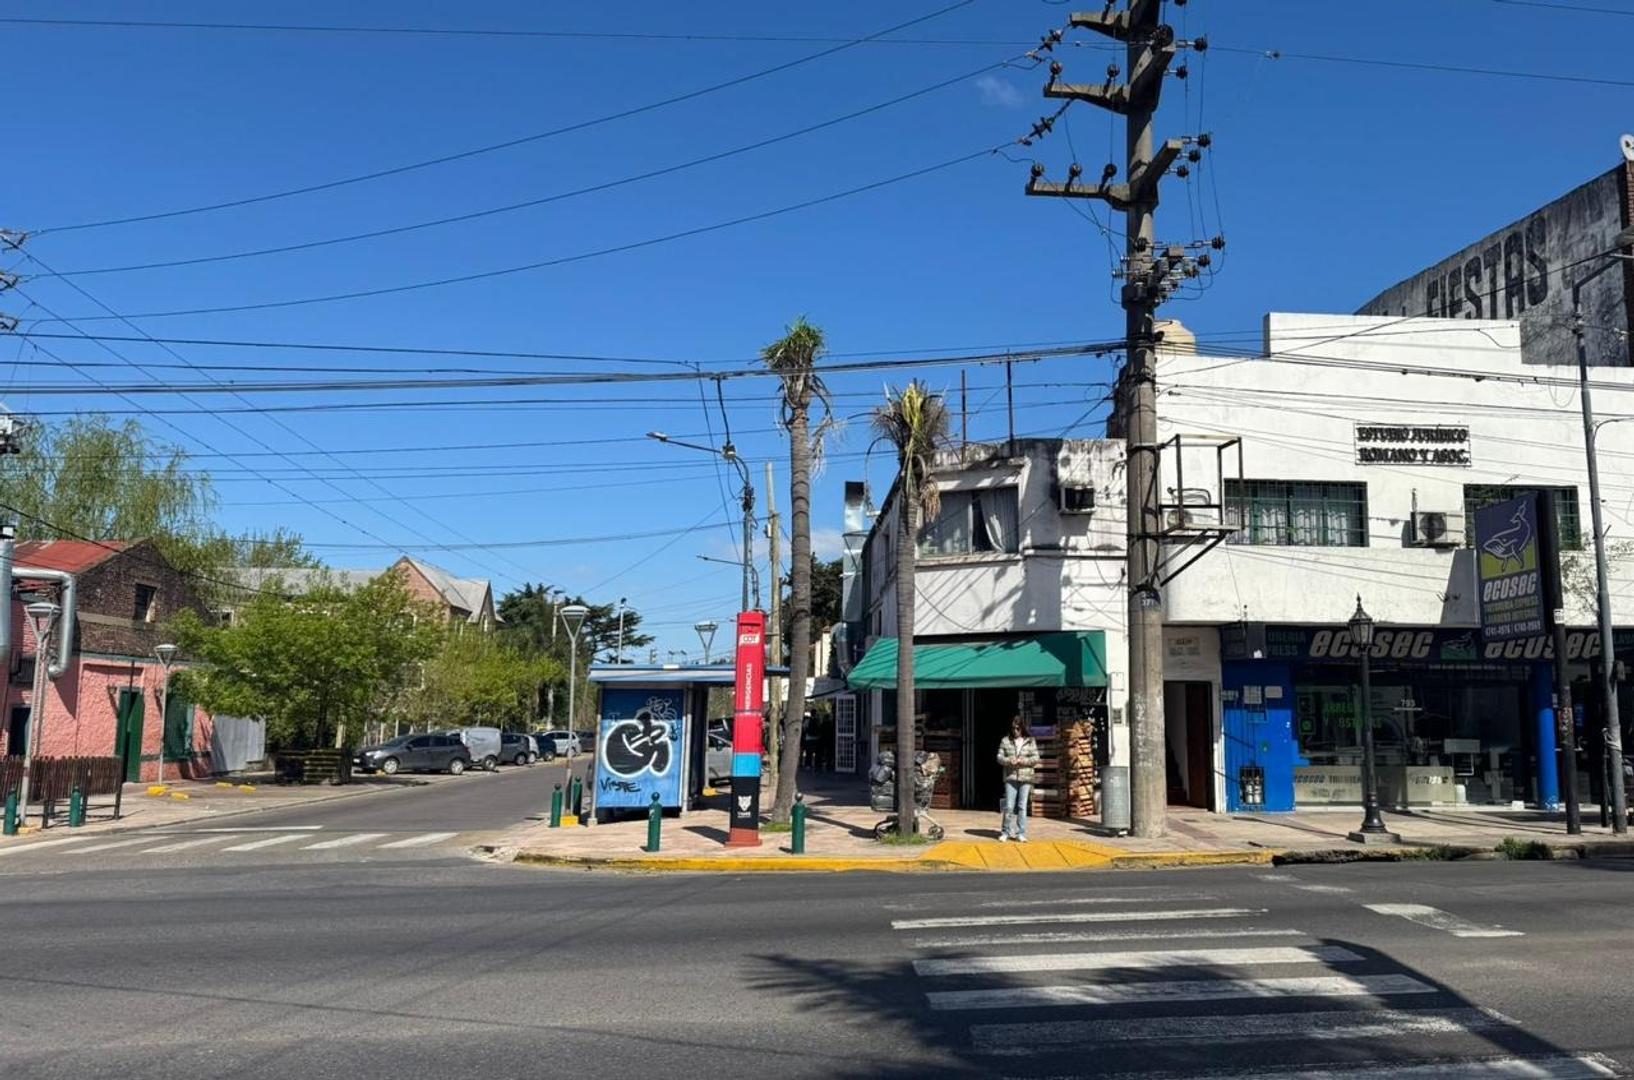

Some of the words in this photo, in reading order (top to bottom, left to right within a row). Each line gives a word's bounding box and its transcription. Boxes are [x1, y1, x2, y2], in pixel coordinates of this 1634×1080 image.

[1356, 426, 1409, 442] ESTUDIO
[1358, 447, 1417, 463] ROMANO
[1418, 448, 1430, 462] Y
